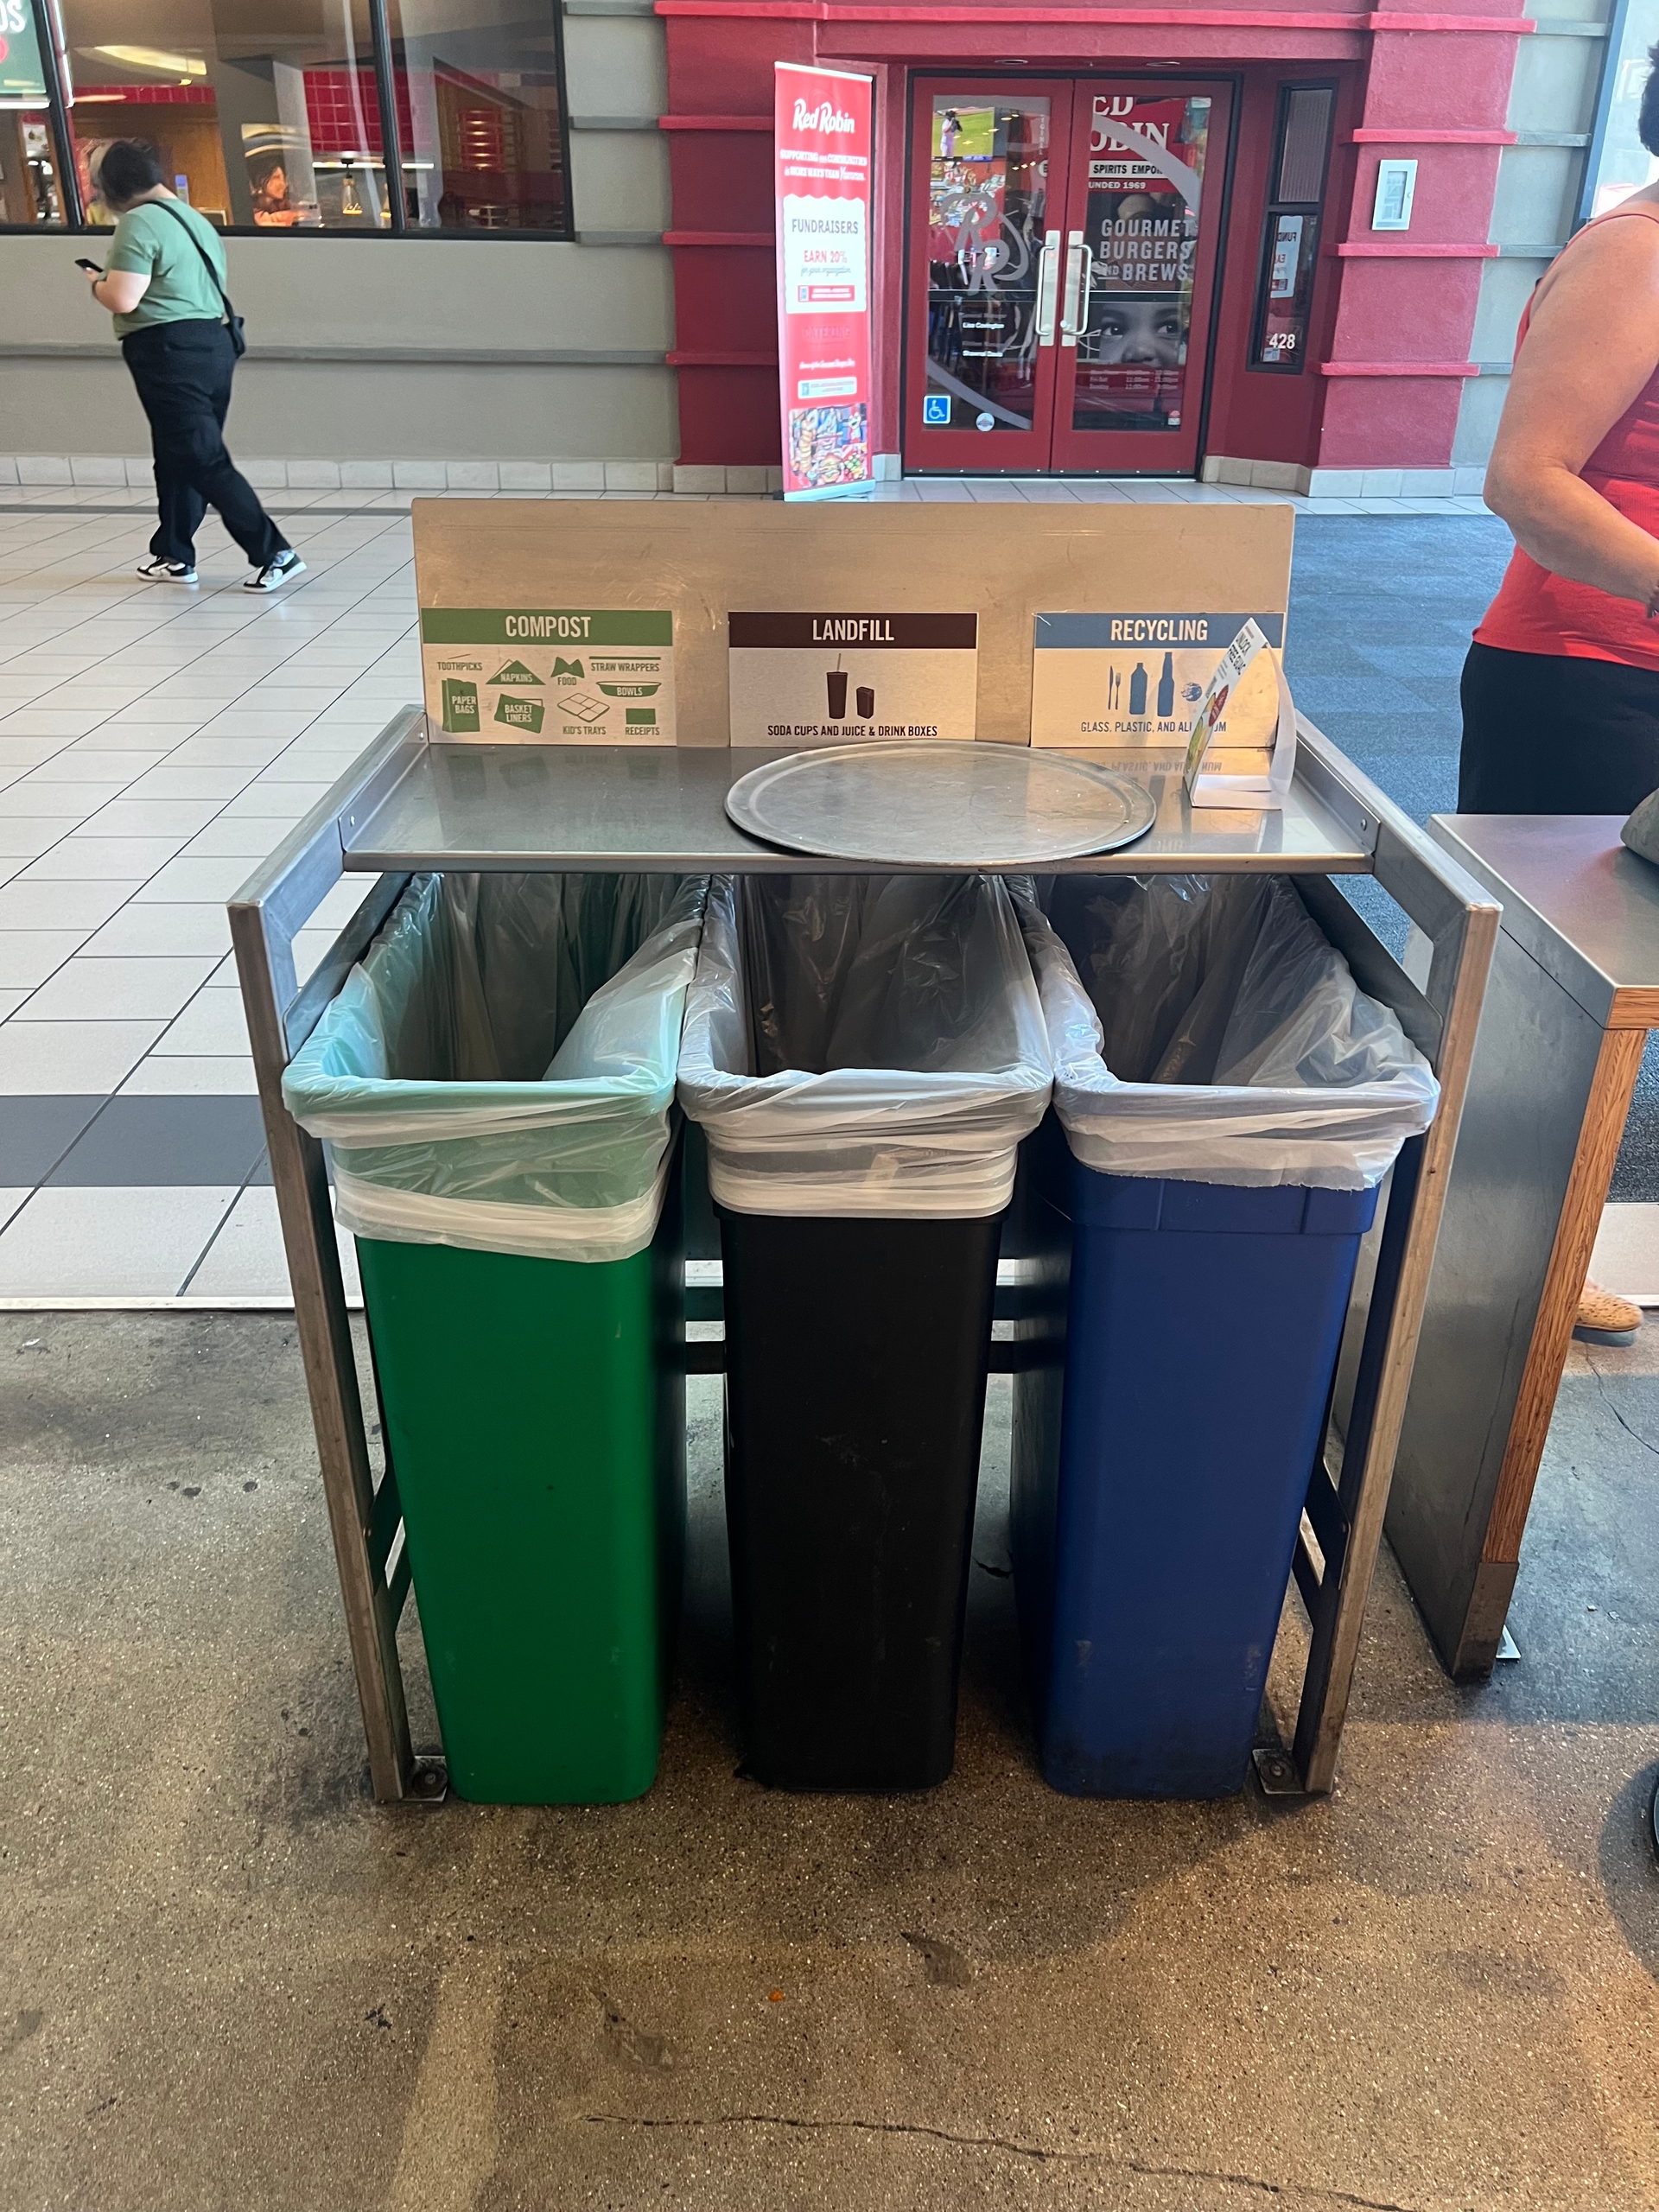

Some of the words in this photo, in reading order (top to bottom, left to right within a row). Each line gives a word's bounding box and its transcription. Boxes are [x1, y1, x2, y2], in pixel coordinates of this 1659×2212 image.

[792, 98, 820, 132] Red
[818, 101, 855, 135] Robin
[1093, 164, 1128, 175] SPIRITS
[791, 219, 859, 235] FUNDRAISERS
[1101, 219, 1191, 238] GOURMET
[1099, 241, 1191, 260] BURGERS
[804, 250, 827, 264] EARN
[830, 250, 848, 264] 20%
[1122, 263, 1190, 282] BREWS
[1268, 333, 1296, 350] 428
[505, 615, 591, 638] COMPOST
[812, 619, 895, 641] LANDFILL
[1110, 619, 1208, 641] RECYCLING
[437, 661, 483, 672] TOOTHPICKS
[591, 663, 617, 672] STRAW
[619, 663, 660, 673] WRAPPERS
[500, 673, 533, 683] NAPKINS
[557, 677, 577, 686] FOOD
[616, 687, 643, 696] BOWLS
[452, 696, 476, 706] PAPER
[454, 705, 474, 715] BAGS
[505, 704, 532, 715] BASKET
[505, 714, 532, 723] LINERS
[563, 726, 582, 735] KID'S
[583, 726, 607, 736] TRAYS
[625, 727, 660, 736] RECEIPTS
[767, 725, 791, 736] SODA
[794, 726, 819, 736] CUPS
[821, 726, 839, 736] AND
[842, 726, 867, 736] JUICE
[868, 726, 875, 736] &
[878, 726, 906, 737] DRINK
[908, 726, 938, 737] BOXES
[1157, 721, 1176, 733] AND
